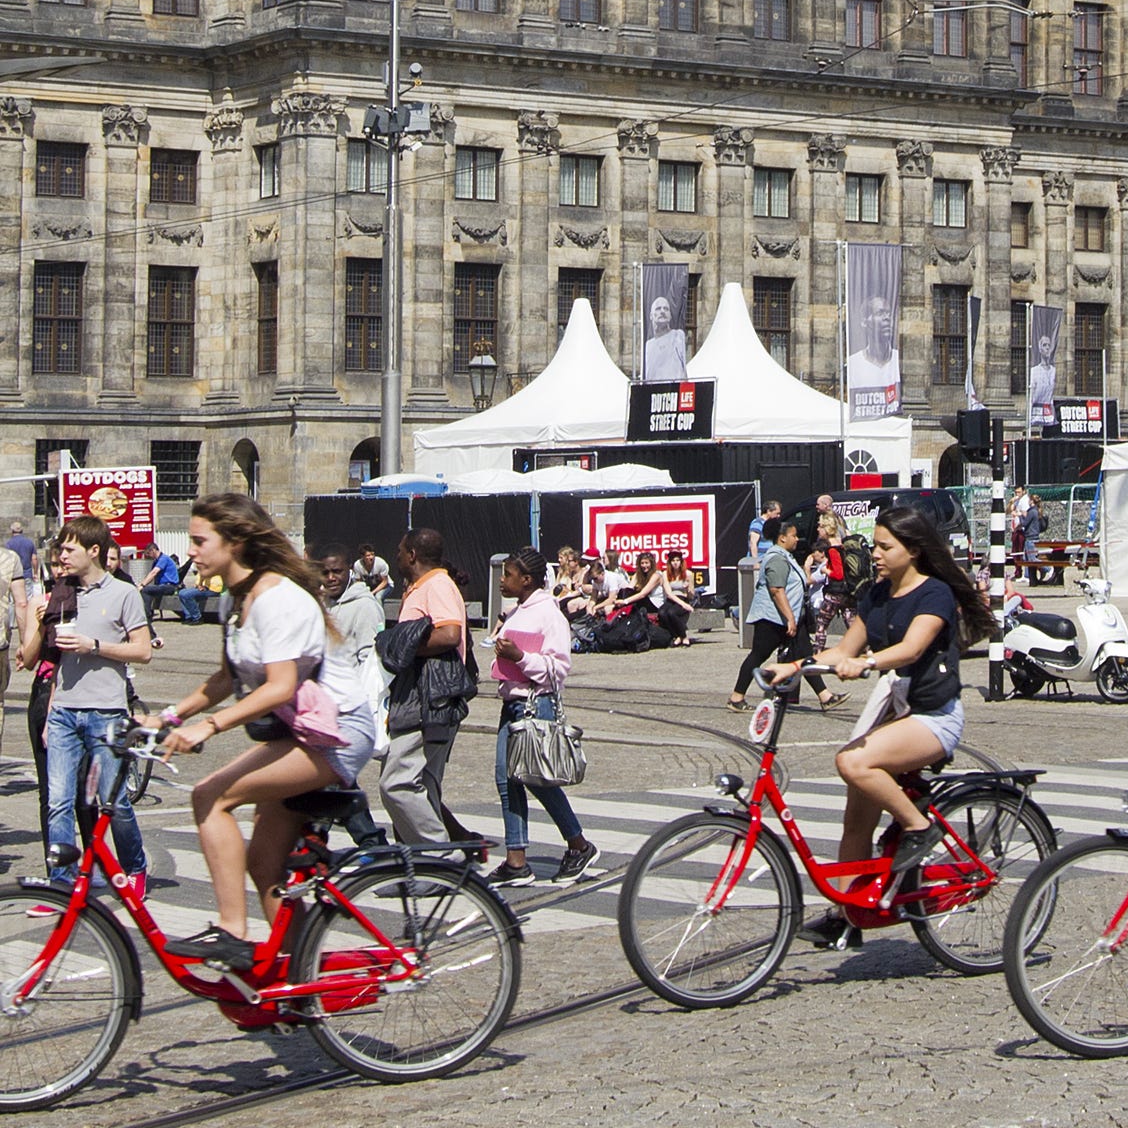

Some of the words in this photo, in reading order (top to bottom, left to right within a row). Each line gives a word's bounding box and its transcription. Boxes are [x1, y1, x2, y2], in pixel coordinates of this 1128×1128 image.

[651, 392, 678, 412] DUTCH
[680, 392, 694, 403] LIFE
[855, 392, 886, 405] DUTCH
[855, 404, 886, 417] STREET
[1060, 406, 1087, 420] DUTCH
[650, 413, 677, 431] STREET
[677, 413, 695, 430] CUP
[1061, 421, 1087, 433] STREET
[1088, 421, 1102, 433] CUP
[68, 470, 147, 485] HOTDOGS
[609, 534, 689, 551] HOMELESS
